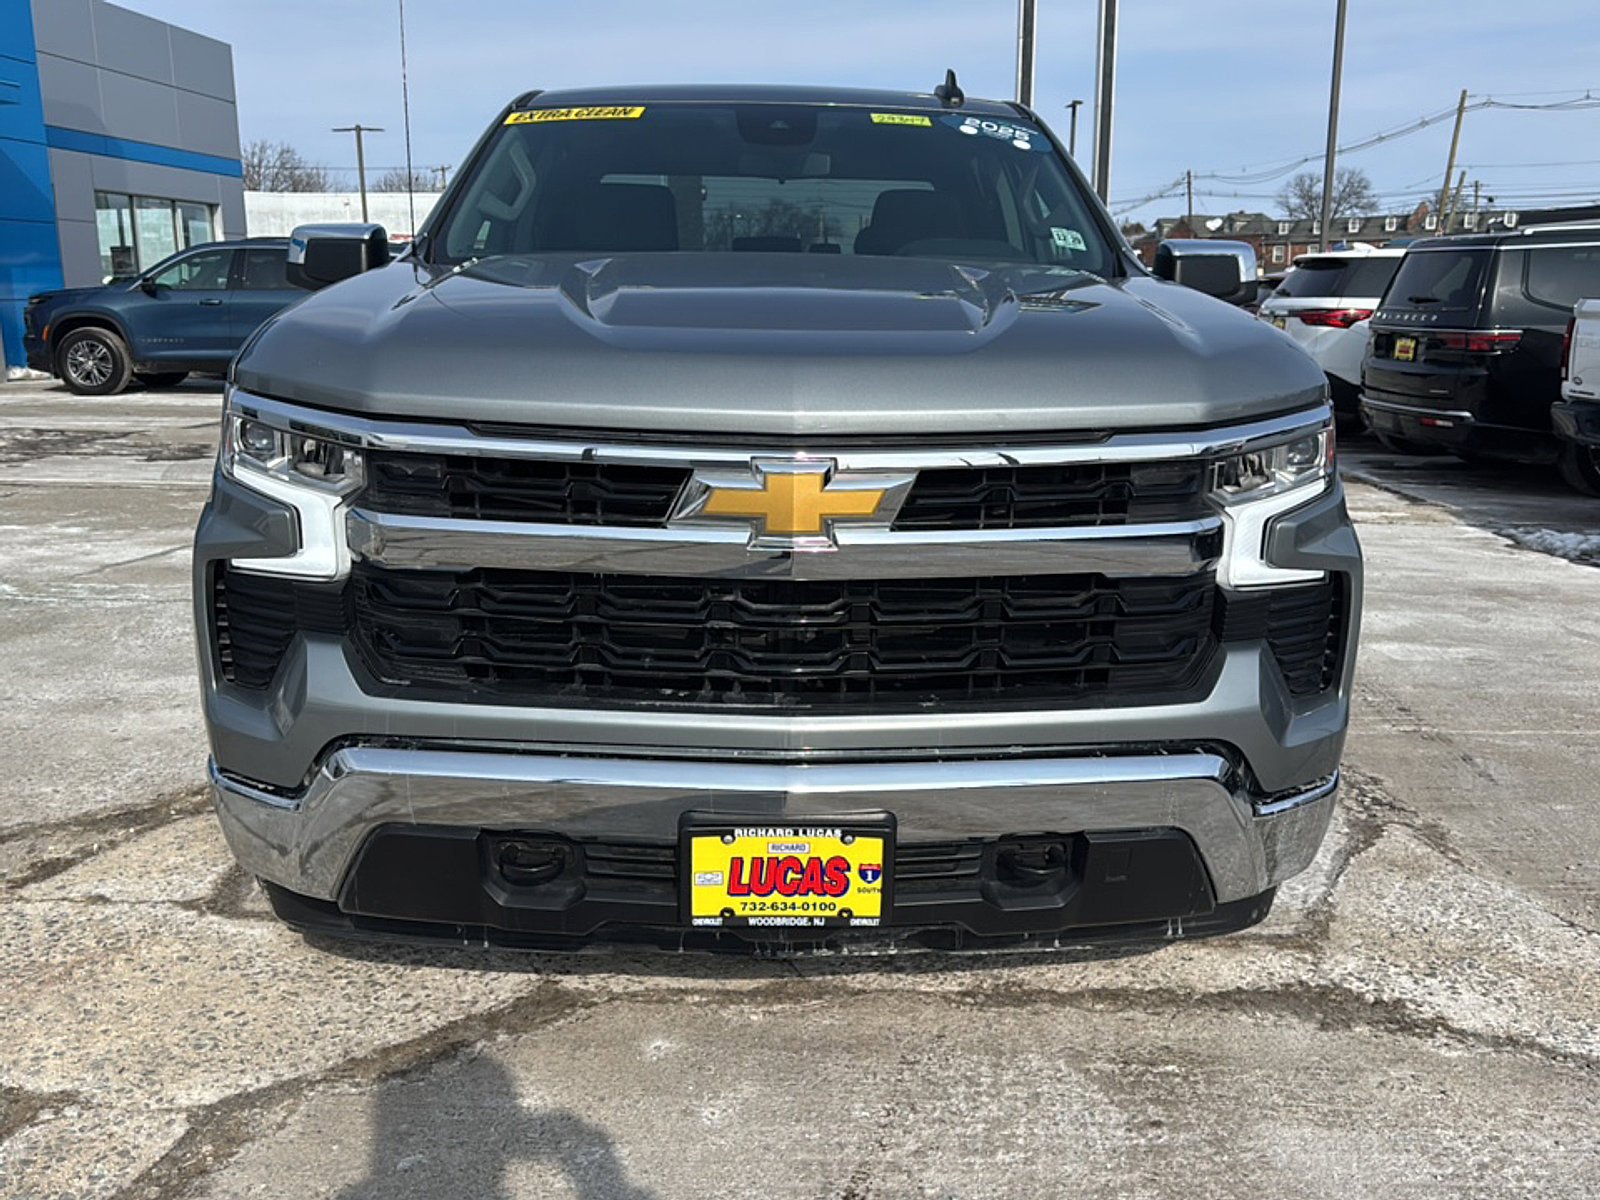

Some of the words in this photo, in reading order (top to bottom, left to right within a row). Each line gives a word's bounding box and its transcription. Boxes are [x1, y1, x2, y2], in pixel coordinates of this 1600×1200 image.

[513, 109, 572, 121] EXTRA
[574, 107, 635, 118] CLEAN
[964, 117, 1030, 141] 2025
[734, 828, 794, 837] RICHARD
[799, 828, 842, 837] LUCAS
[771, 843, 807, 852] RICHARD
[727, 855, 851, 897] LUCAS
[864, 870, 873, 881] 1
[740, 901, 836, 912] 732-634-0100
[814, 917, 825, 926] NJ
